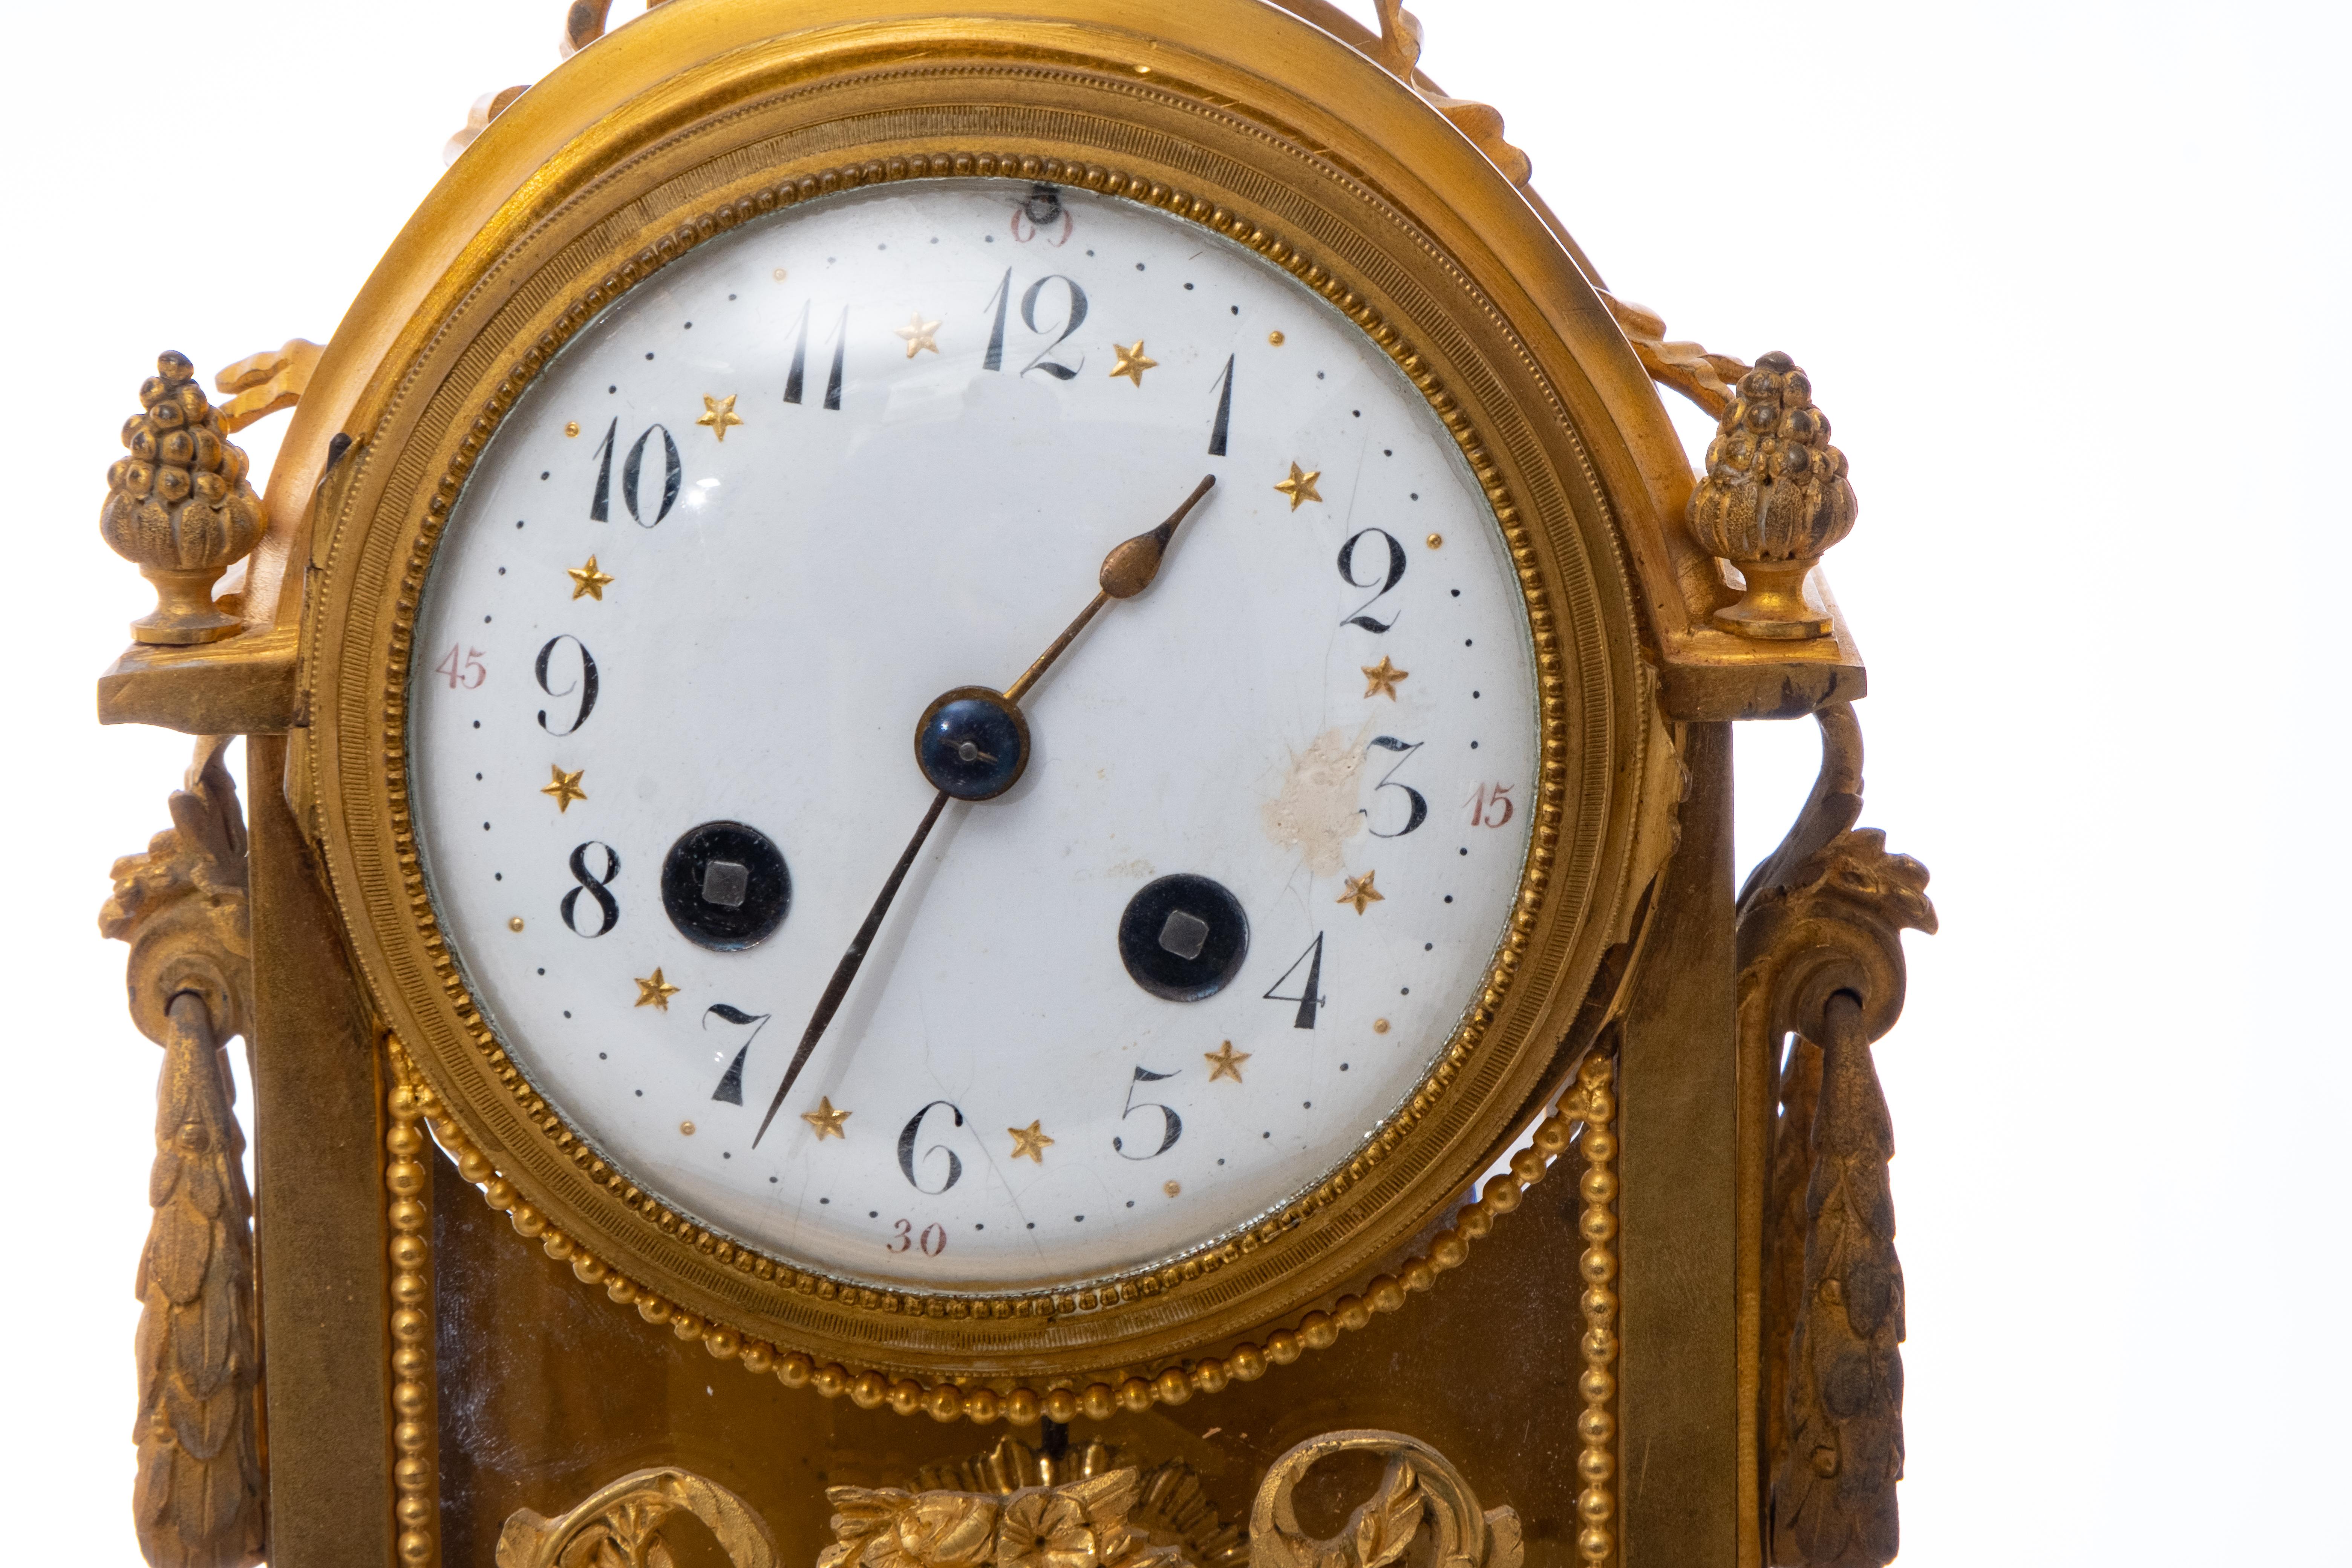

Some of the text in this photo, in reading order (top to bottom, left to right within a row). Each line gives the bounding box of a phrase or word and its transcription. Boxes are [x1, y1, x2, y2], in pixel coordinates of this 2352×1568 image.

[784, 298, 844, 410] 11
[984, 266, 1088, 380] 12
[1208, 353, 1234, 456] 1
[590, 416, 681, 528] 10
[1337, 528, 1407, 634] 2
[435, 642, 486, 690] 45
[535, 635, 599, 734] 9
[1359, 737, 1427, 838] 3
[1463, 782, 1514, 828] 15
[560, 841, 621, 938] 8
[1262, 931, 1326, 1029] 4
[703, 1004, 772, 1107] 7
[897, 1101, 963, 1193] 6
[1113, 1066, 1182, 1158] 5
[887, 1219, 947, 1257] 30
